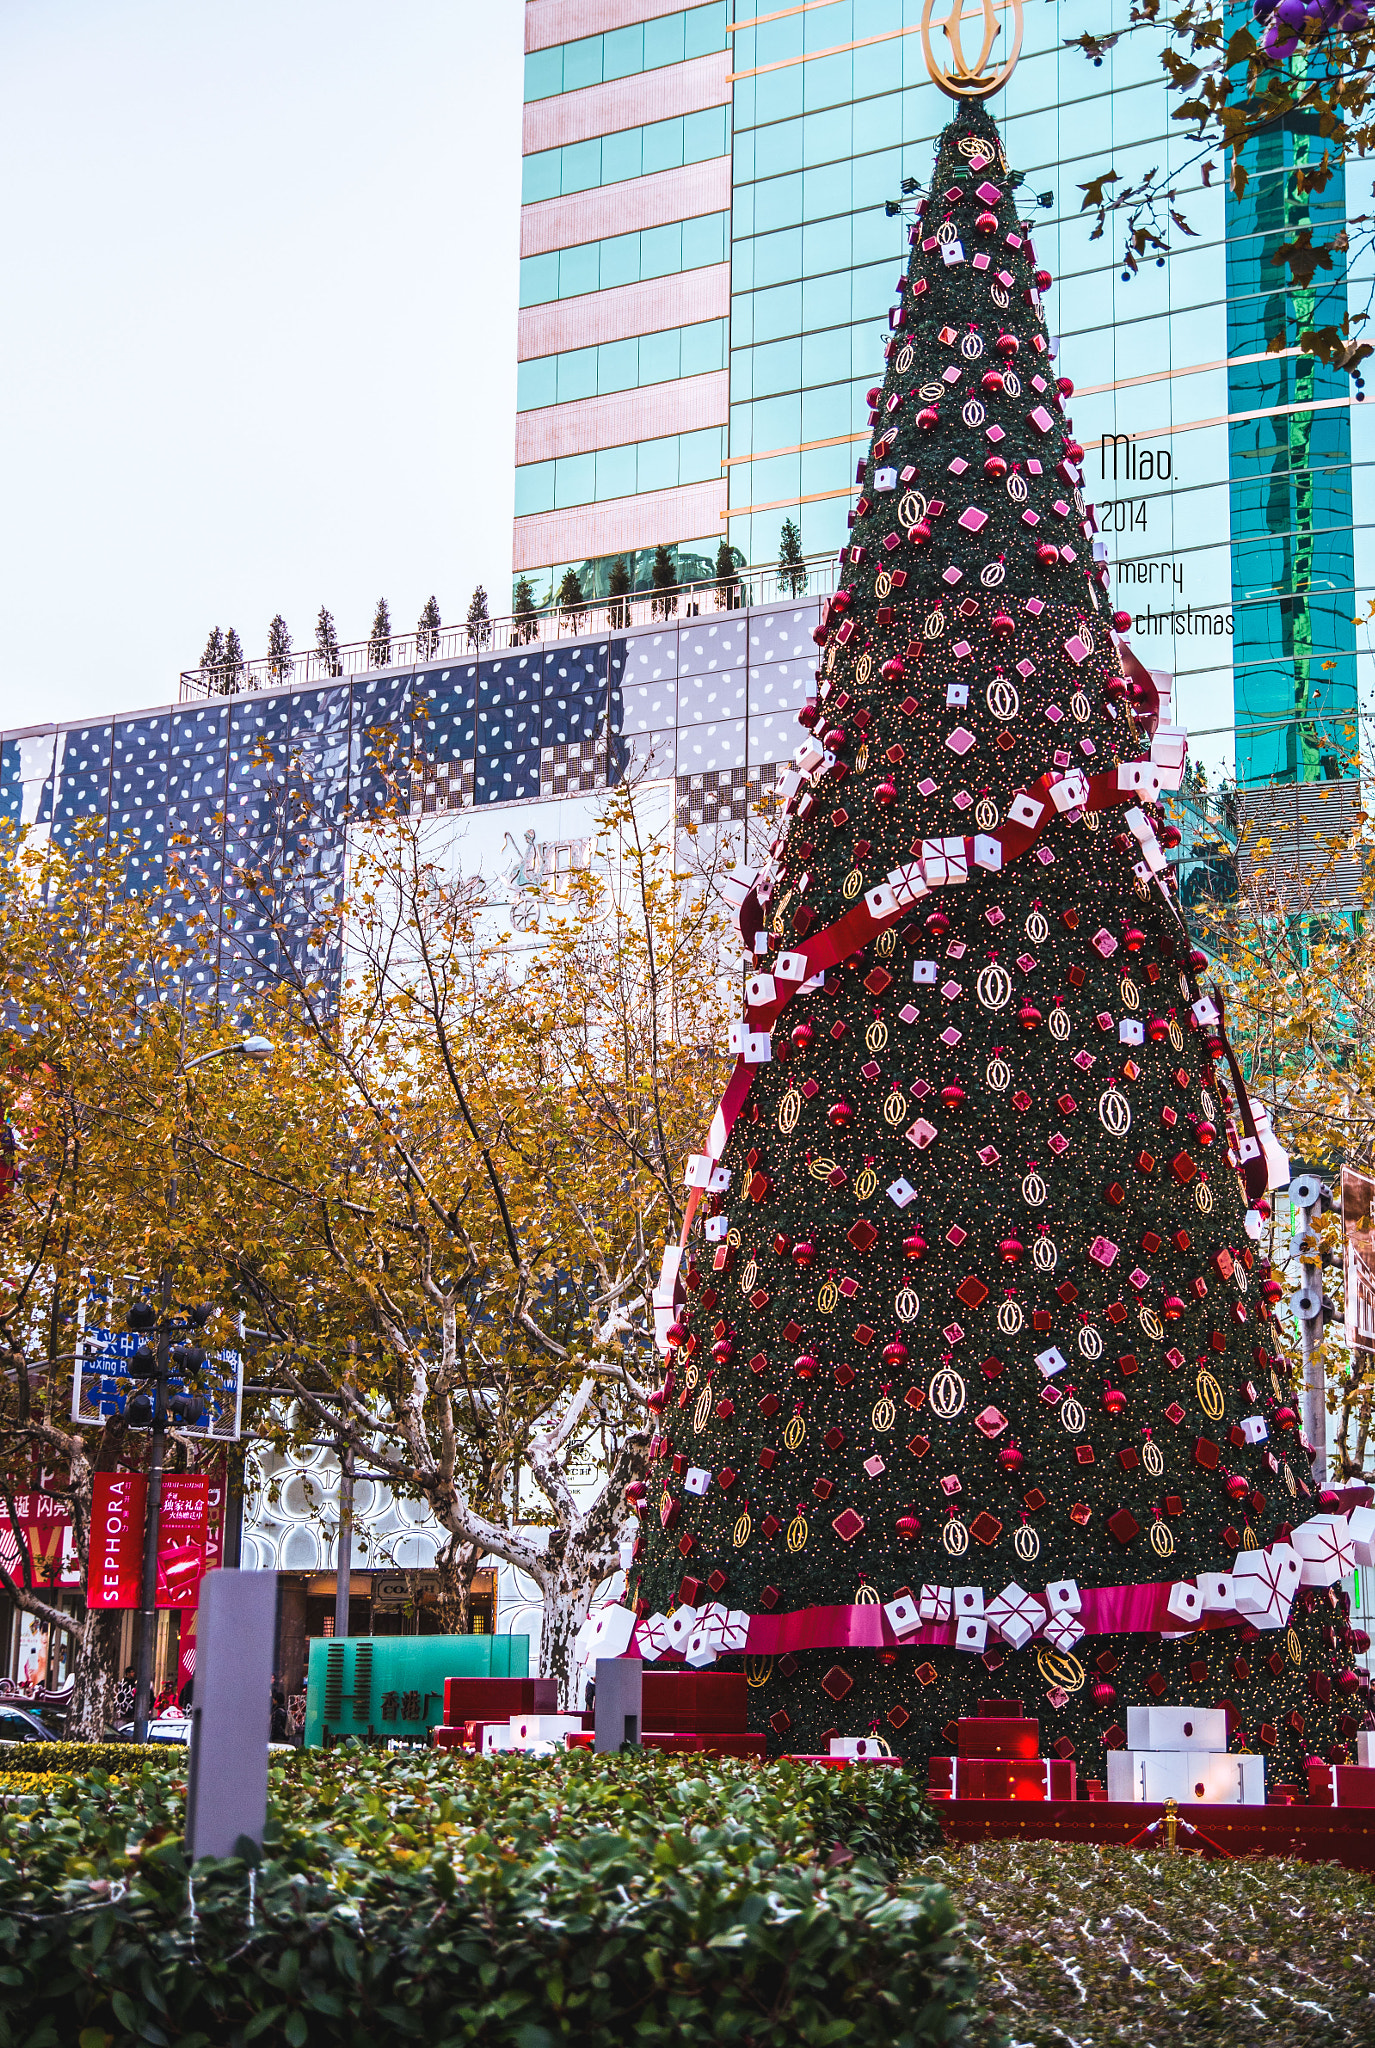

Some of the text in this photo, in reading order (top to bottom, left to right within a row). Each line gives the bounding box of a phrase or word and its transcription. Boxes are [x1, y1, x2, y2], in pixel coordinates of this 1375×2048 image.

[160, 1499, 204, 1513] 独家礼盒
[103, 1482, 125, 1601] SEPHORA
[383, 1585, 435, 1594] COH
